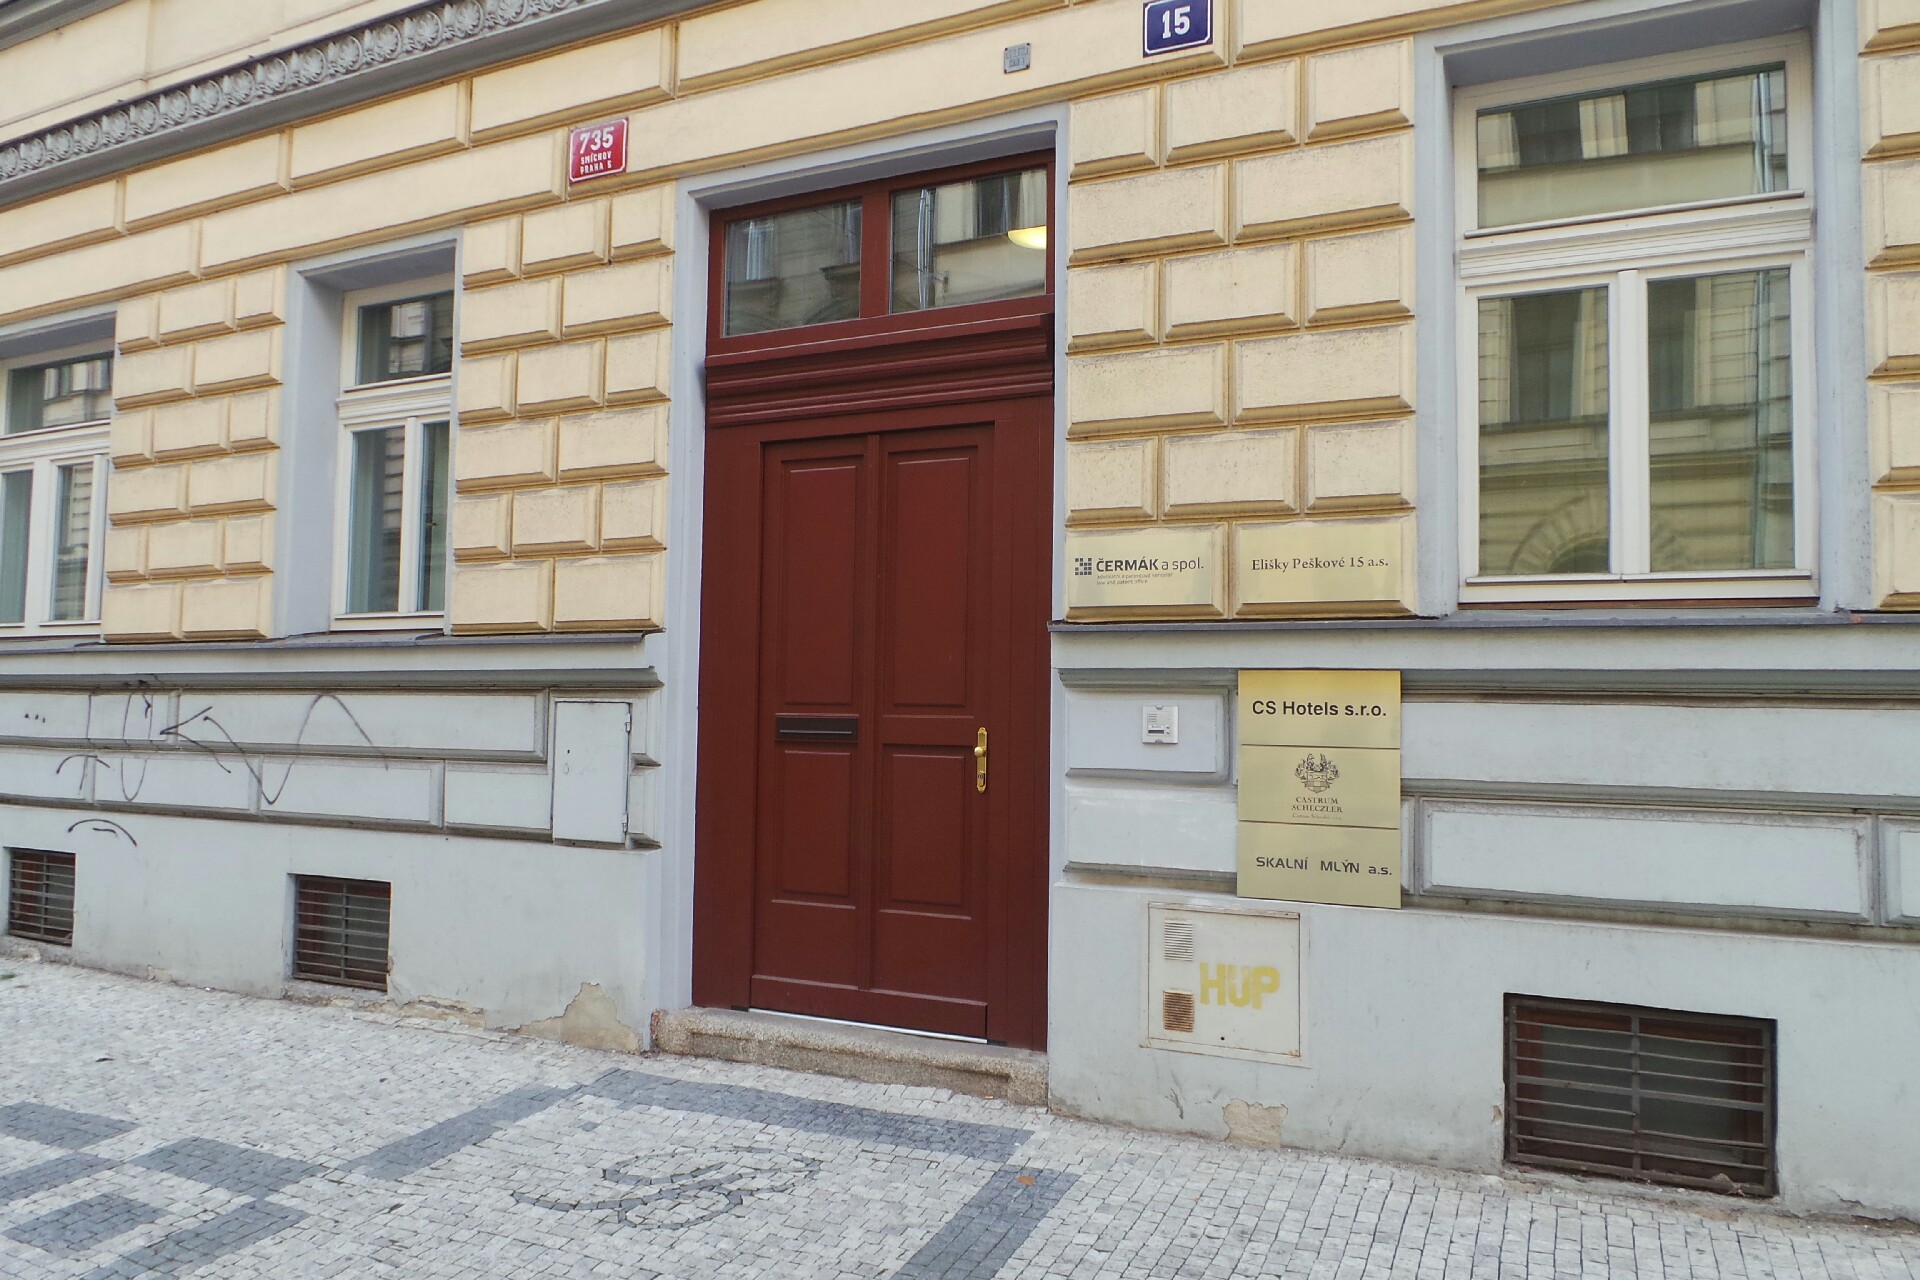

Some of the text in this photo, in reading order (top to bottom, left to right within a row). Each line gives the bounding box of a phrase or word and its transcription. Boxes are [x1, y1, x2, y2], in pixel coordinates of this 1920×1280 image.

[1161, 5, 1191, 39] 15
[580, 126, 615, 154] 735
[580, 151, 612, 165] SMÍCHOV
[580, 160, 612, 175] PRAHA 5
[1096, 556, 1204, 572] ČERMÁK a spol.
[1251, 556, 1389, 573] Elišky Peškové 15 a.s.
[1252, 700, 1387, 717] CS Hotels s.r.o.
[1291, 804, 1343, 813] SCHECZLER
[1295, 796, 1339, 804] CASTRUM
[1256, 856, 1393, 876] SKALNÍ MLÝN a.s.
[1200, 962, 1281, 1009] HUP
